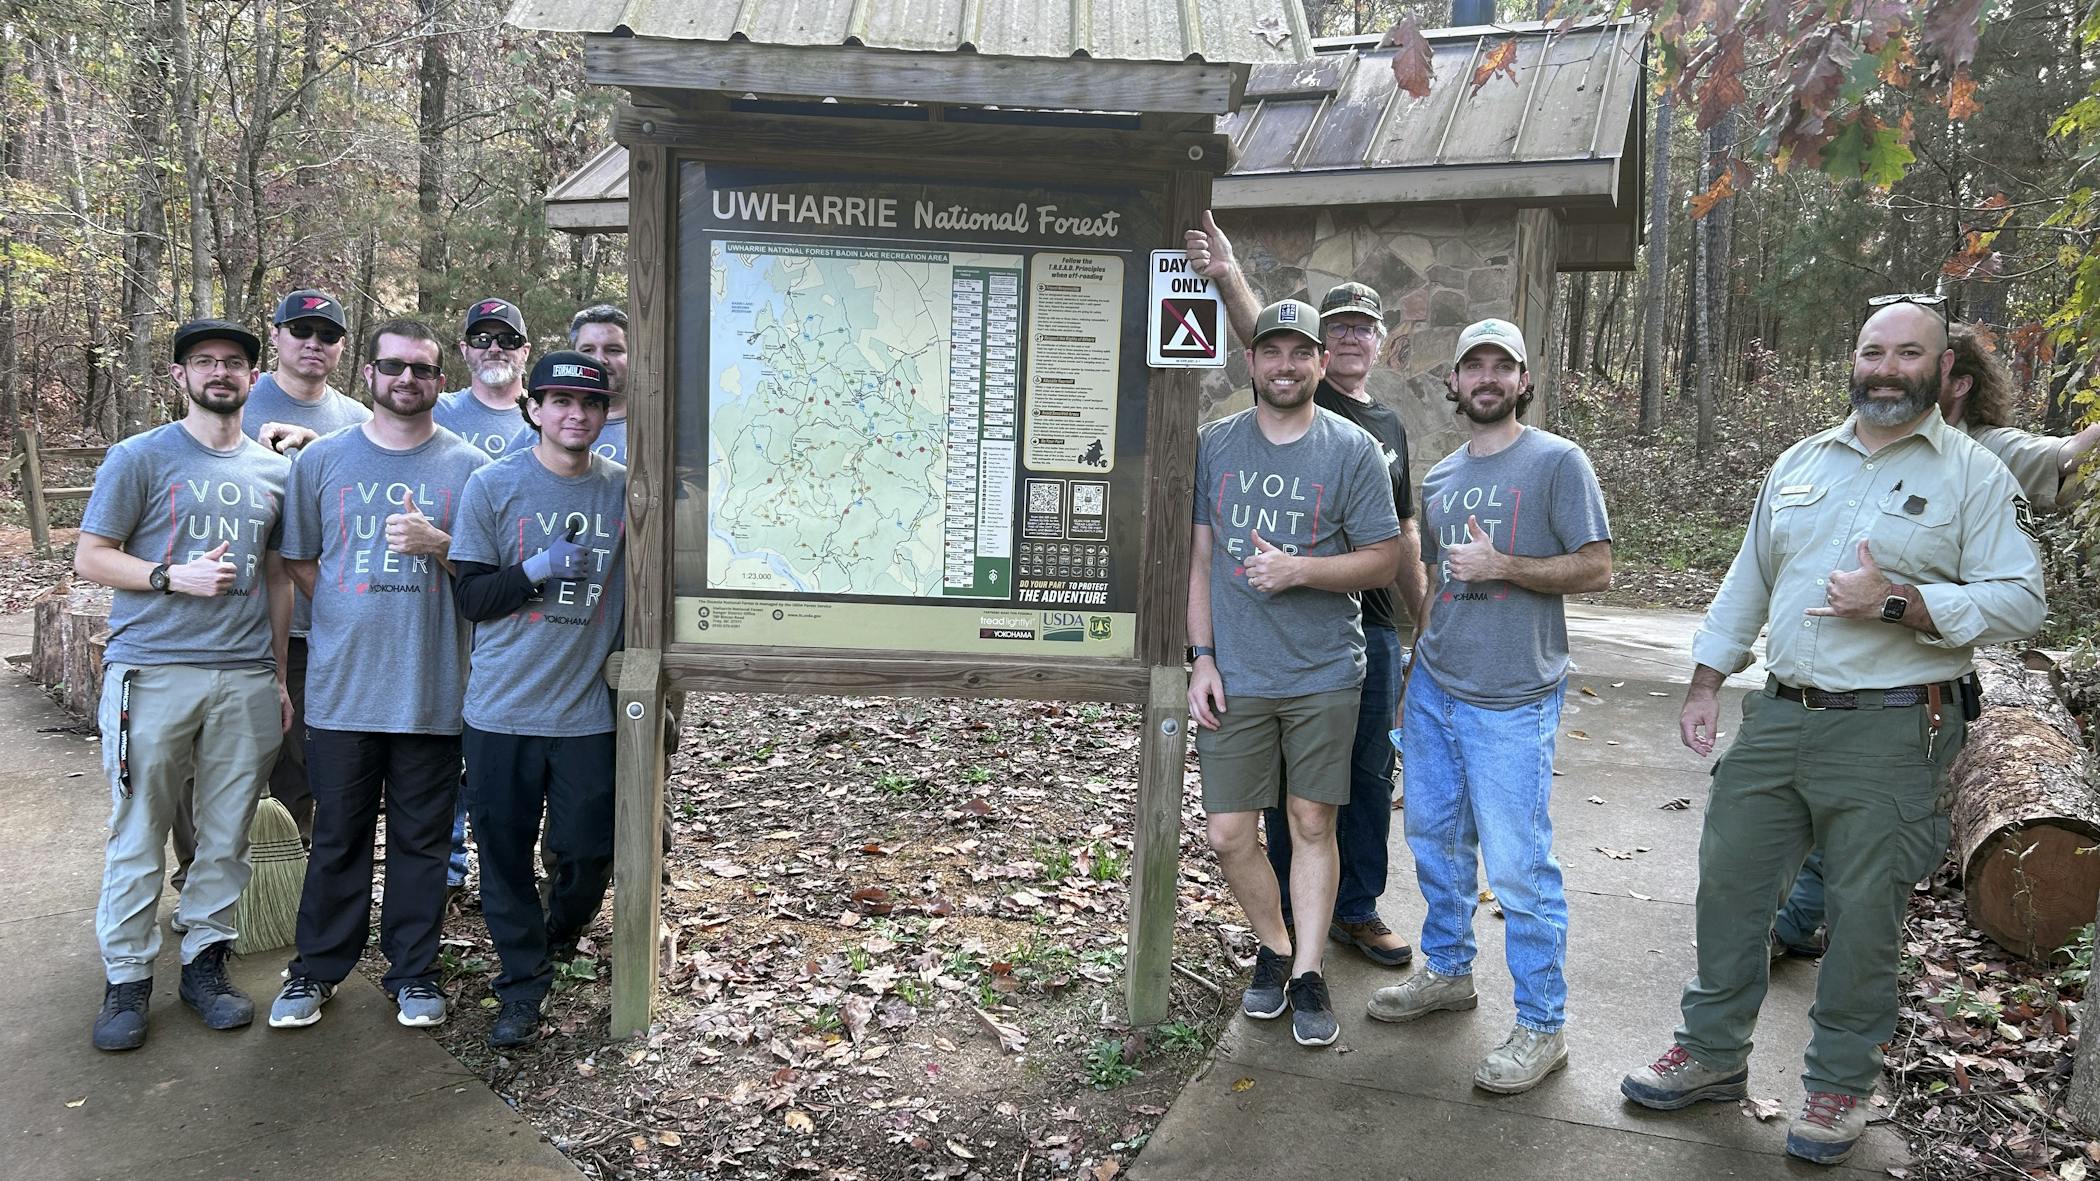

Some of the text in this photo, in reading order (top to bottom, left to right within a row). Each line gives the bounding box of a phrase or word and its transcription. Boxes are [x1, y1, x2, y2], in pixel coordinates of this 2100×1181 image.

[713, 190, 1120, 237] UWHARRIE National Forest
[727, 244, 767, 253] UWHARRIE
[768, 246, 804, 255] NATIONAL
[805, 248, 834, 256] FOREST
[881, 252, 927, 261] RECREATION
[928, 254, 948, 262] AREA
[1075, 265, 1106, 273] Principles
[1160, 258, 1188, 273] DAY
[1068, 273, 1104, 281] off-roading
[1171, 278, 1210, 293] ONLY
[555, 366, 583, 376] FORMULA
[461, 431, 506, 454] VO
[187, 479, 264, 509] VOL
[357, 482, 434, 506] VOL
[1239, 470, 1305, 501] VOL
[1442, 485, 1502, 514] VOL
[536, 511, 610, 538] VOL
[1232, 503, 1305, 535] UNT
[189, 515, 264, 543] UNT
[355, 550, 429, 574] EER
[742, 572, 772, 580] 1:23,000
[1019, 579, 1108, 591] DO YOUR PART TO PROTECT
[371, 584, 421, 593] YOKOHAMA
[527, 581, 603, 607] ER
[1018, 589, 1108, 604] THE ADVENTURE
[1043, 612, 1085, 627] USDA
[993, 630, 1033, 639] YOKOHAMA
